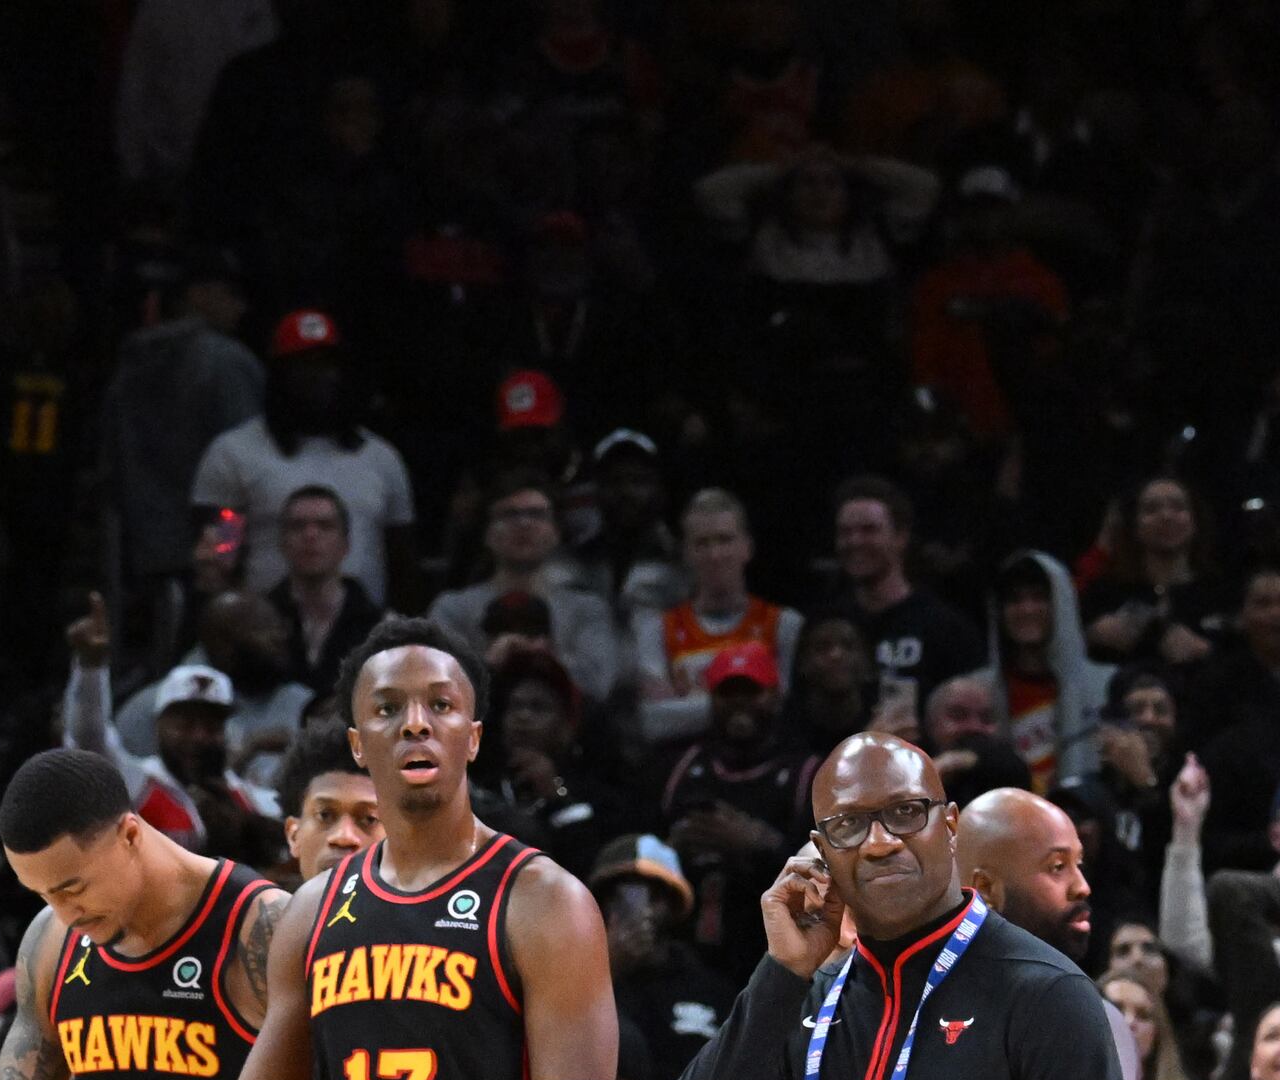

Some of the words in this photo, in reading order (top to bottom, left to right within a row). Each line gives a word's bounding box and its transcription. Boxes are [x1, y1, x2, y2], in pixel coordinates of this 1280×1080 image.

[342, 874, 359, 894] 6
[310, 943, 478, 1019] HAWKS
[57, 1013, 221, 1078] HAWKS
